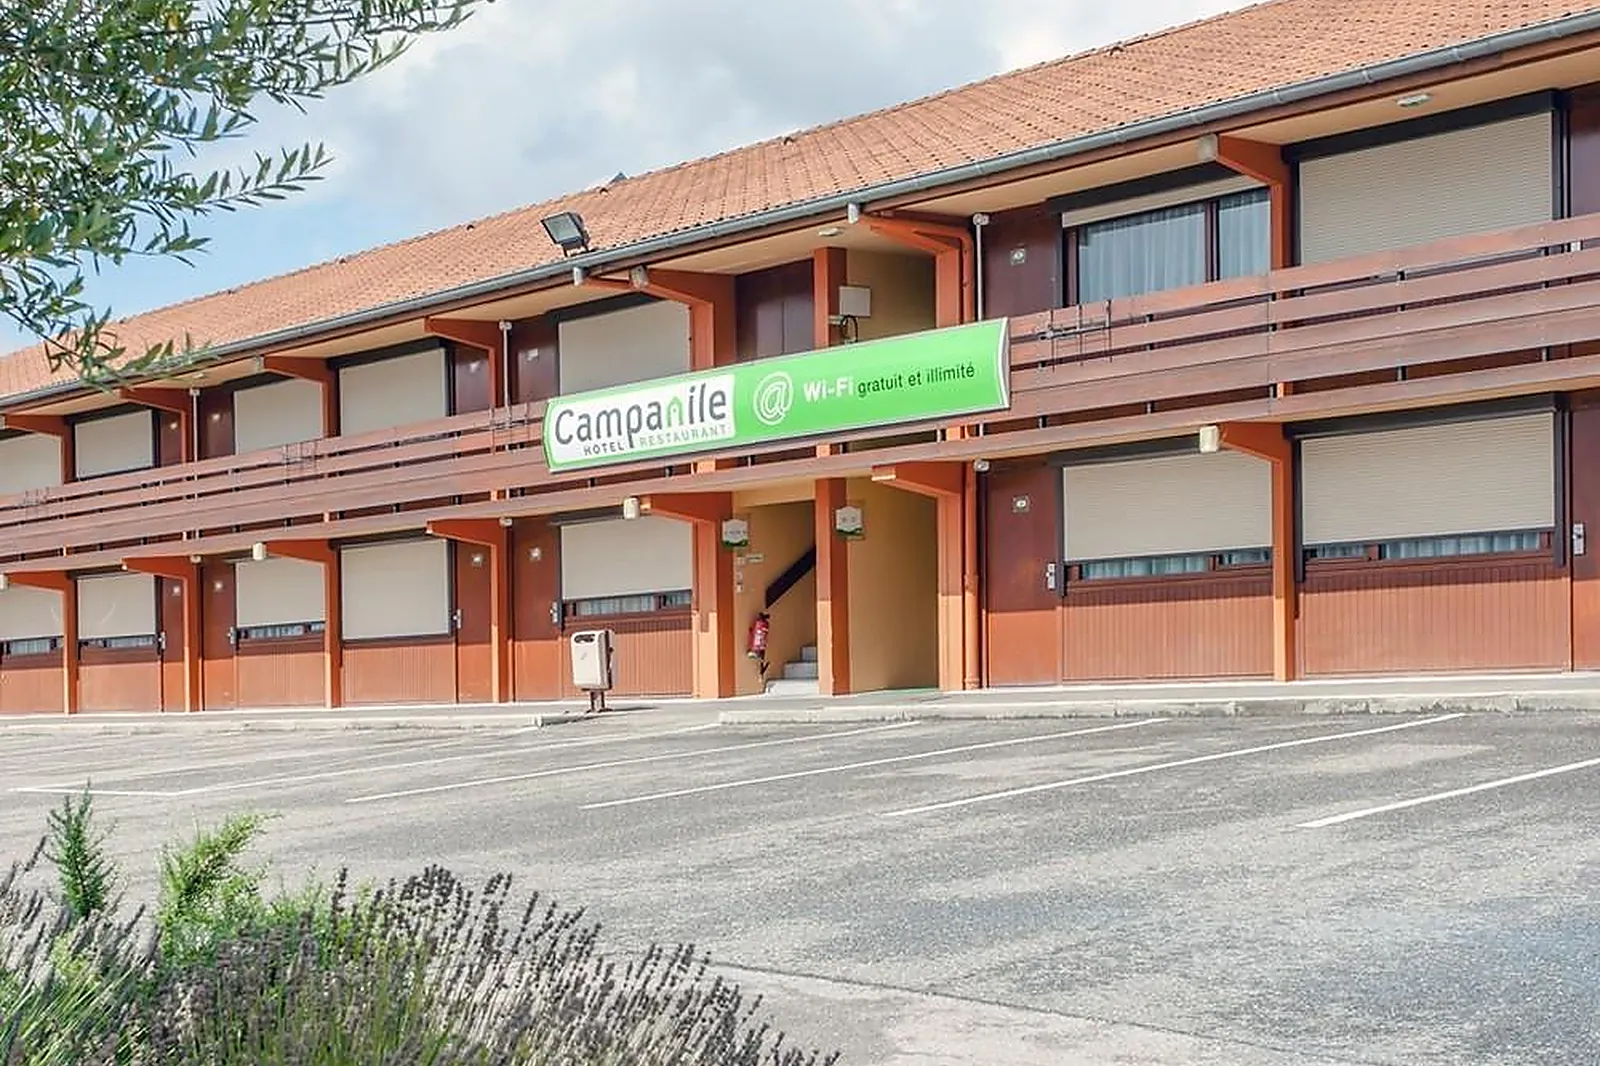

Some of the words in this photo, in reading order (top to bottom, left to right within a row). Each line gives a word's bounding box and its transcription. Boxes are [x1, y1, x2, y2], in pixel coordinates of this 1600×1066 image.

[803, 376, 854, 403] Wi-Fi
[858, 374, 903, 398] gratuit
[908, 372, 922, 387] et
[927, 362, 975, 383] illimité
[555, 382, 727, 449] Campanile
[584, 442, 623, 456] HOTEL
[640, 424, 727, 448] RESTAURANT
